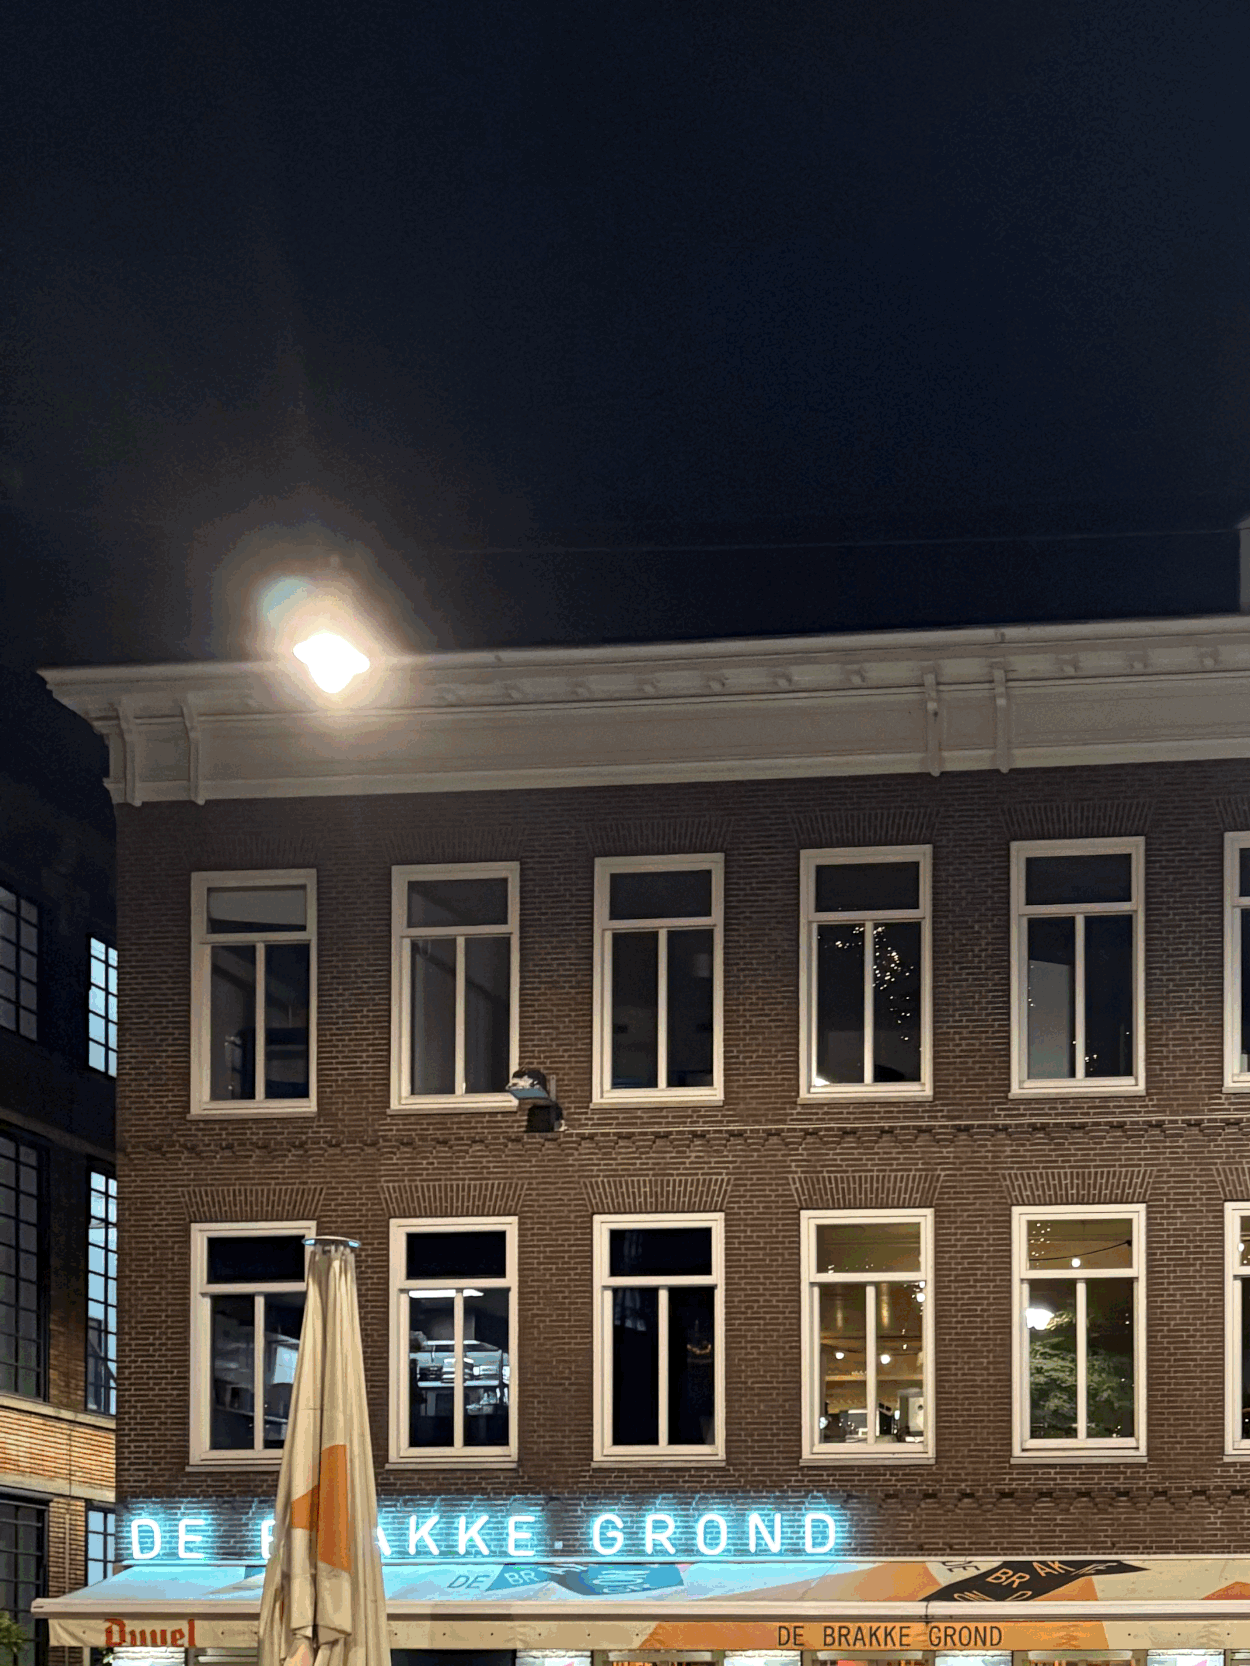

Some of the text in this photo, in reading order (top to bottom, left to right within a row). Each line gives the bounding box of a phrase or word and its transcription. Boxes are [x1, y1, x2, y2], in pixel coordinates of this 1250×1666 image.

[130, 1518, 206, 1560] DE
[592, 1512, 836, 1556] GROND
[446, 1573, 491, 1590] DE
[104, 1618, 197, 1647] Duvel
[777, 1625, 1003, 1647] DE BRAKKE GROND
